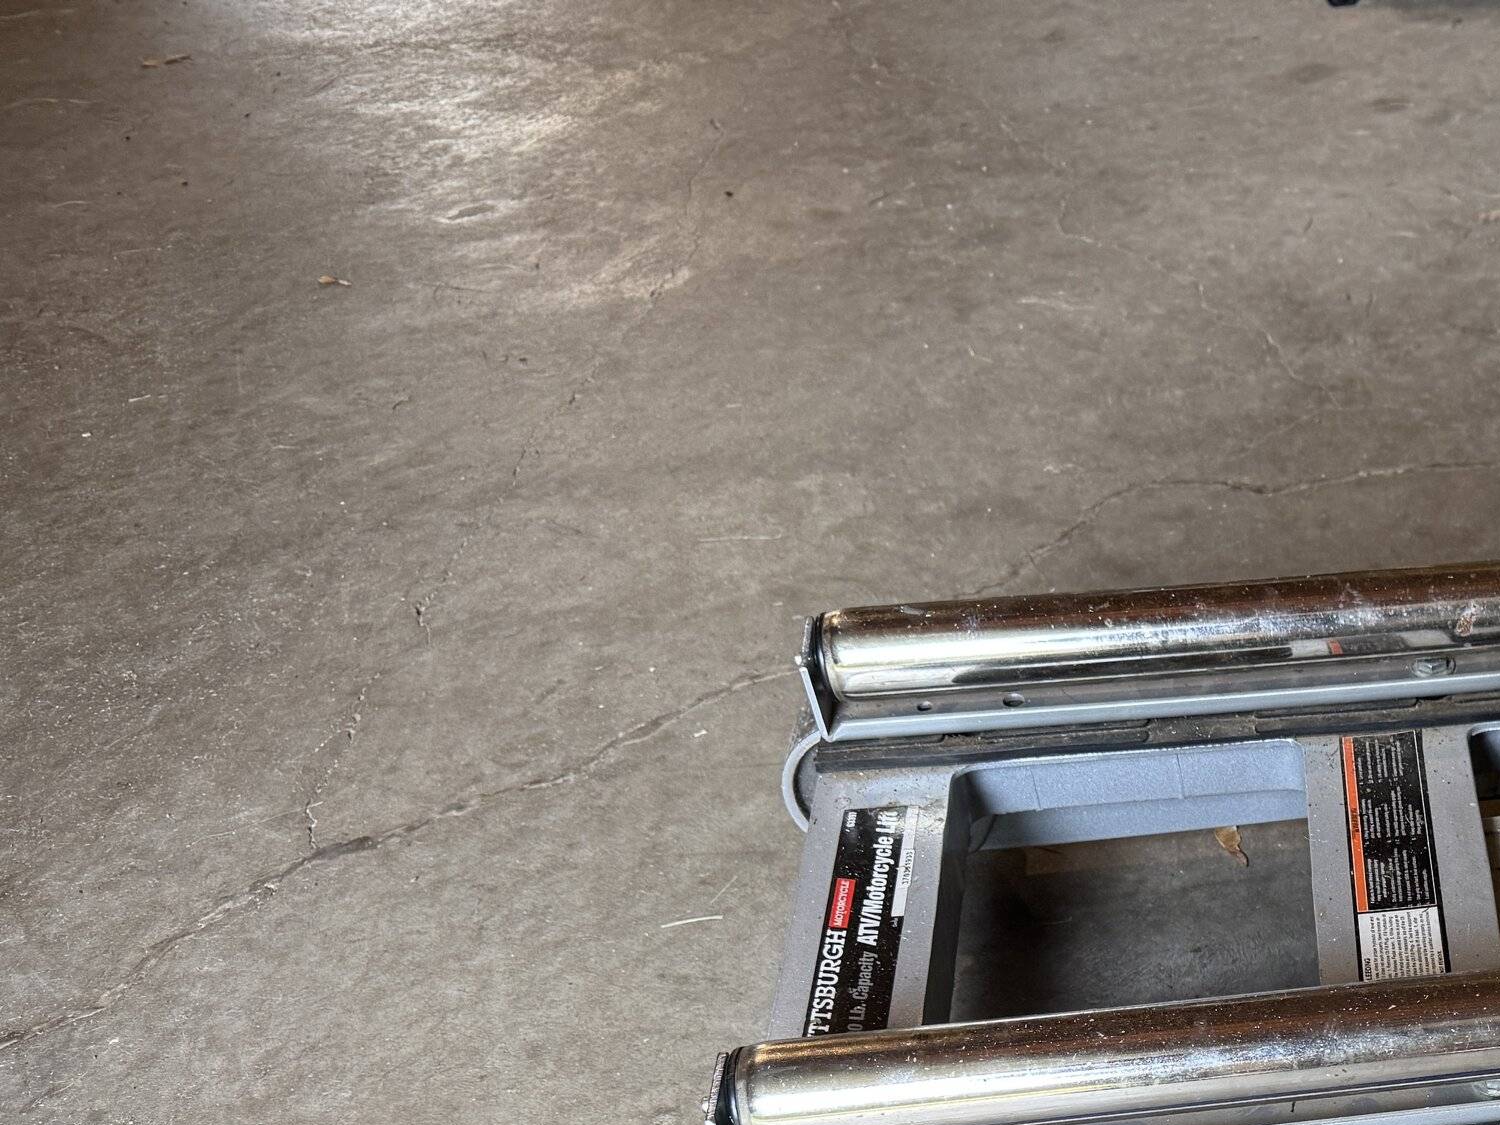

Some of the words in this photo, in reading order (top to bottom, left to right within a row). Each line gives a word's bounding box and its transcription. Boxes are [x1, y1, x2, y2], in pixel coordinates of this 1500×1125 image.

[876, 811, 899, 834] Lift
[832, 880, 849, 927] MOTORCYCLE
[857, 833, 894, 947] ATV/Motorcycle
[852, 951, 877, 1000] Capacity
[849, 1002, 866, 1023] Lb.
